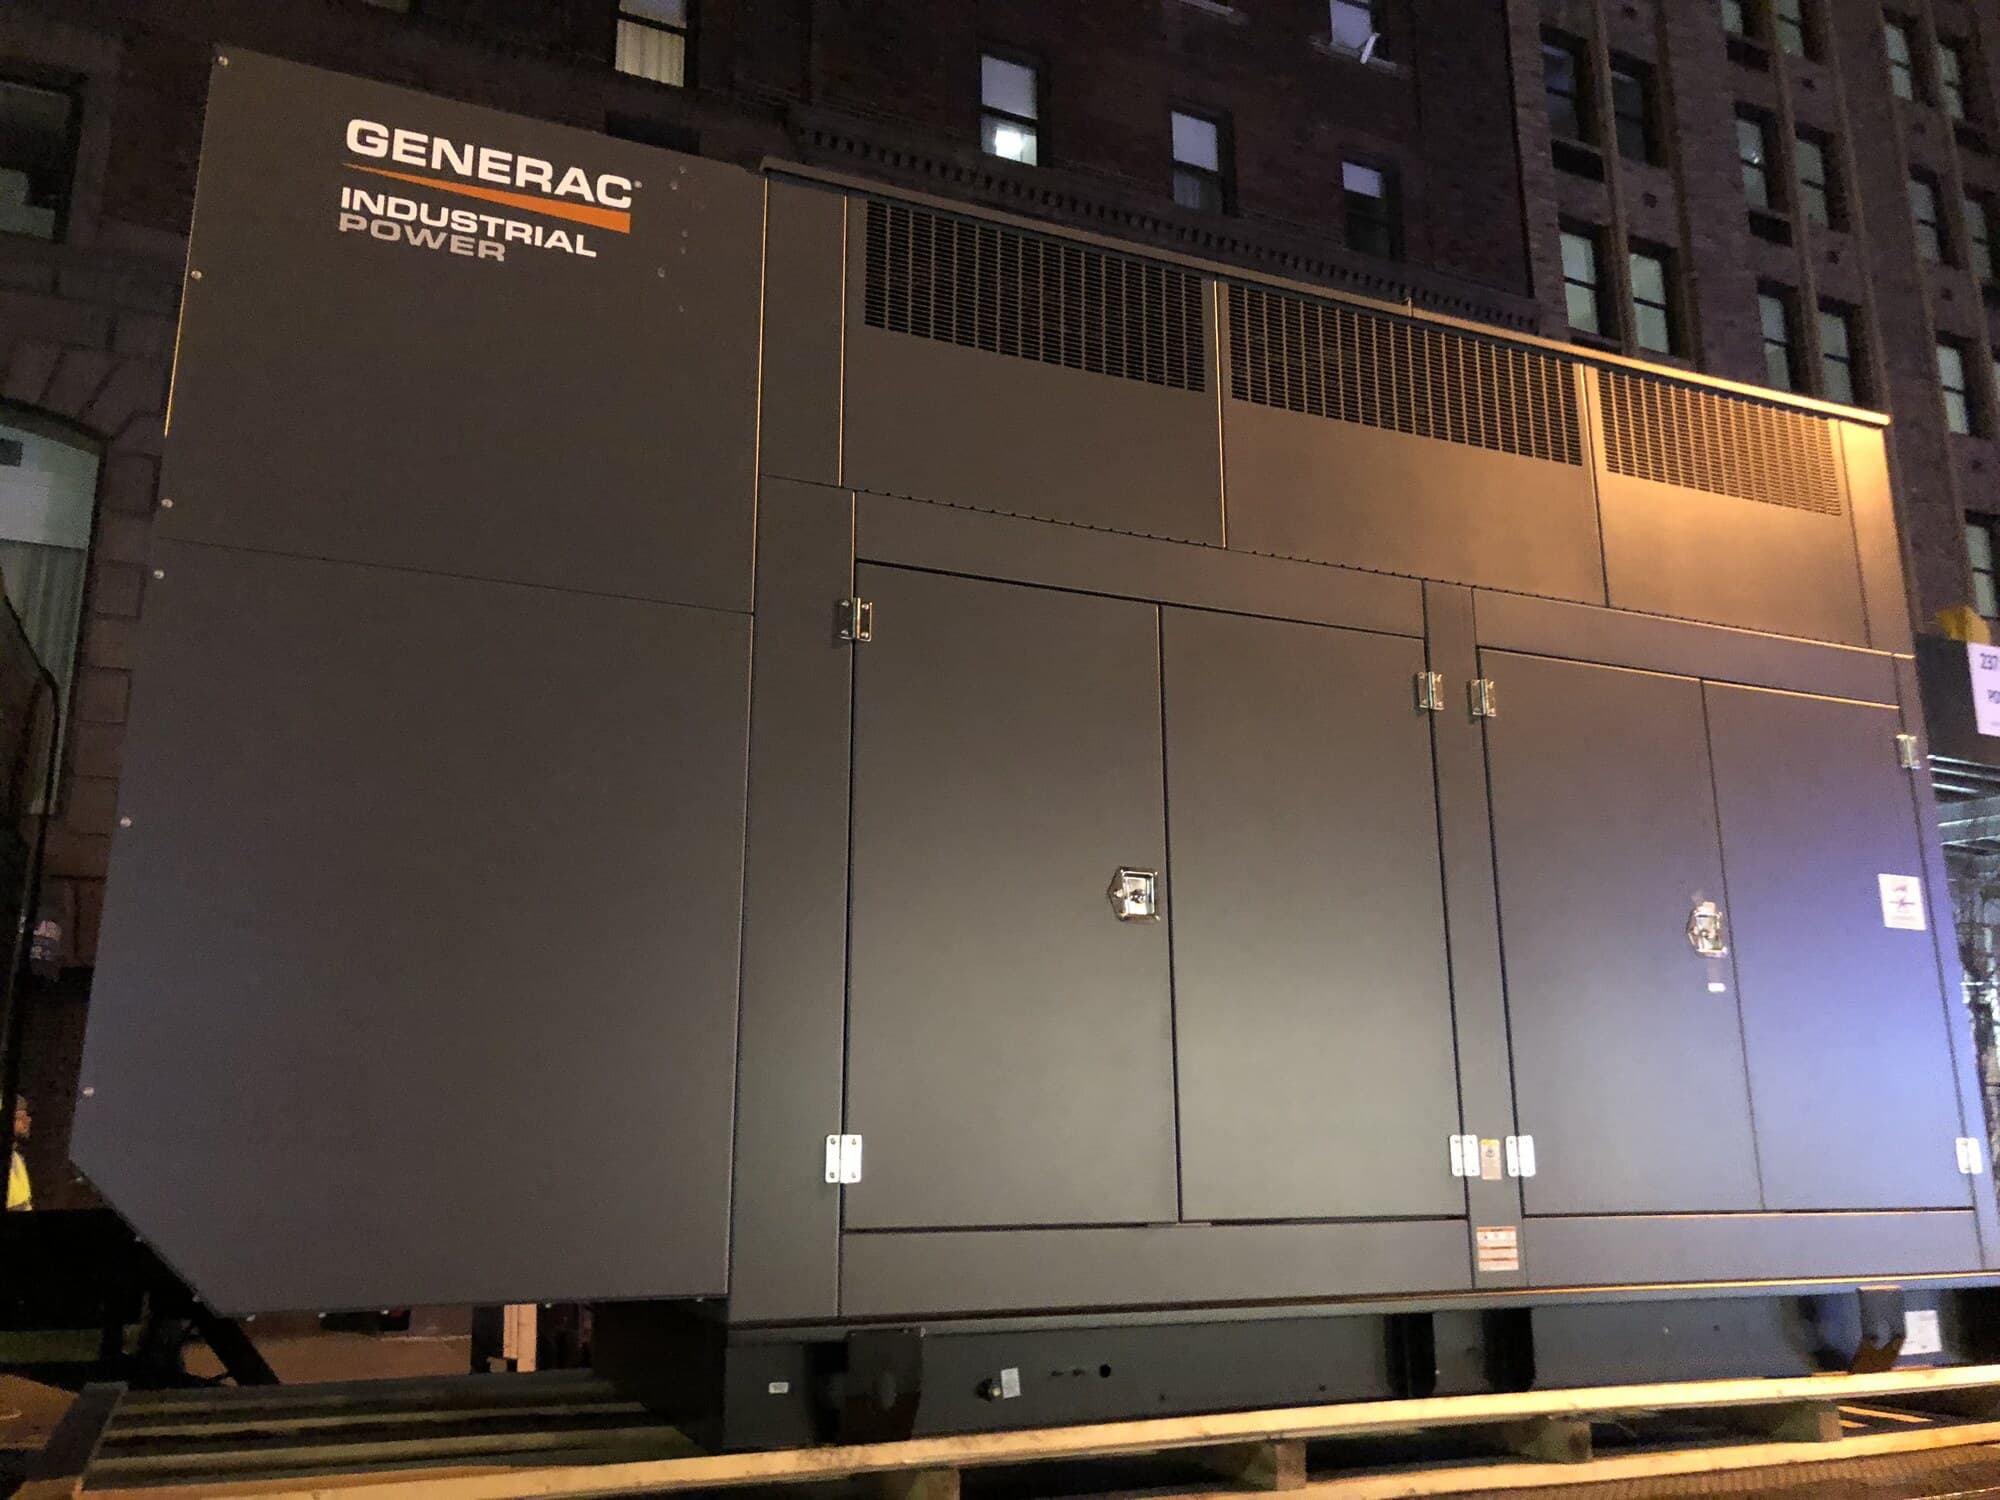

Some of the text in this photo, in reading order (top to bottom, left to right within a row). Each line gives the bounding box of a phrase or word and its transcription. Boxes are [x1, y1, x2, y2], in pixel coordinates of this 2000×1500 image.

[346, 118, 632, 209] GENERAC
[339, 213, 506, 262] POWER
[341, 187, 597, 258] INDUSTRIAL
